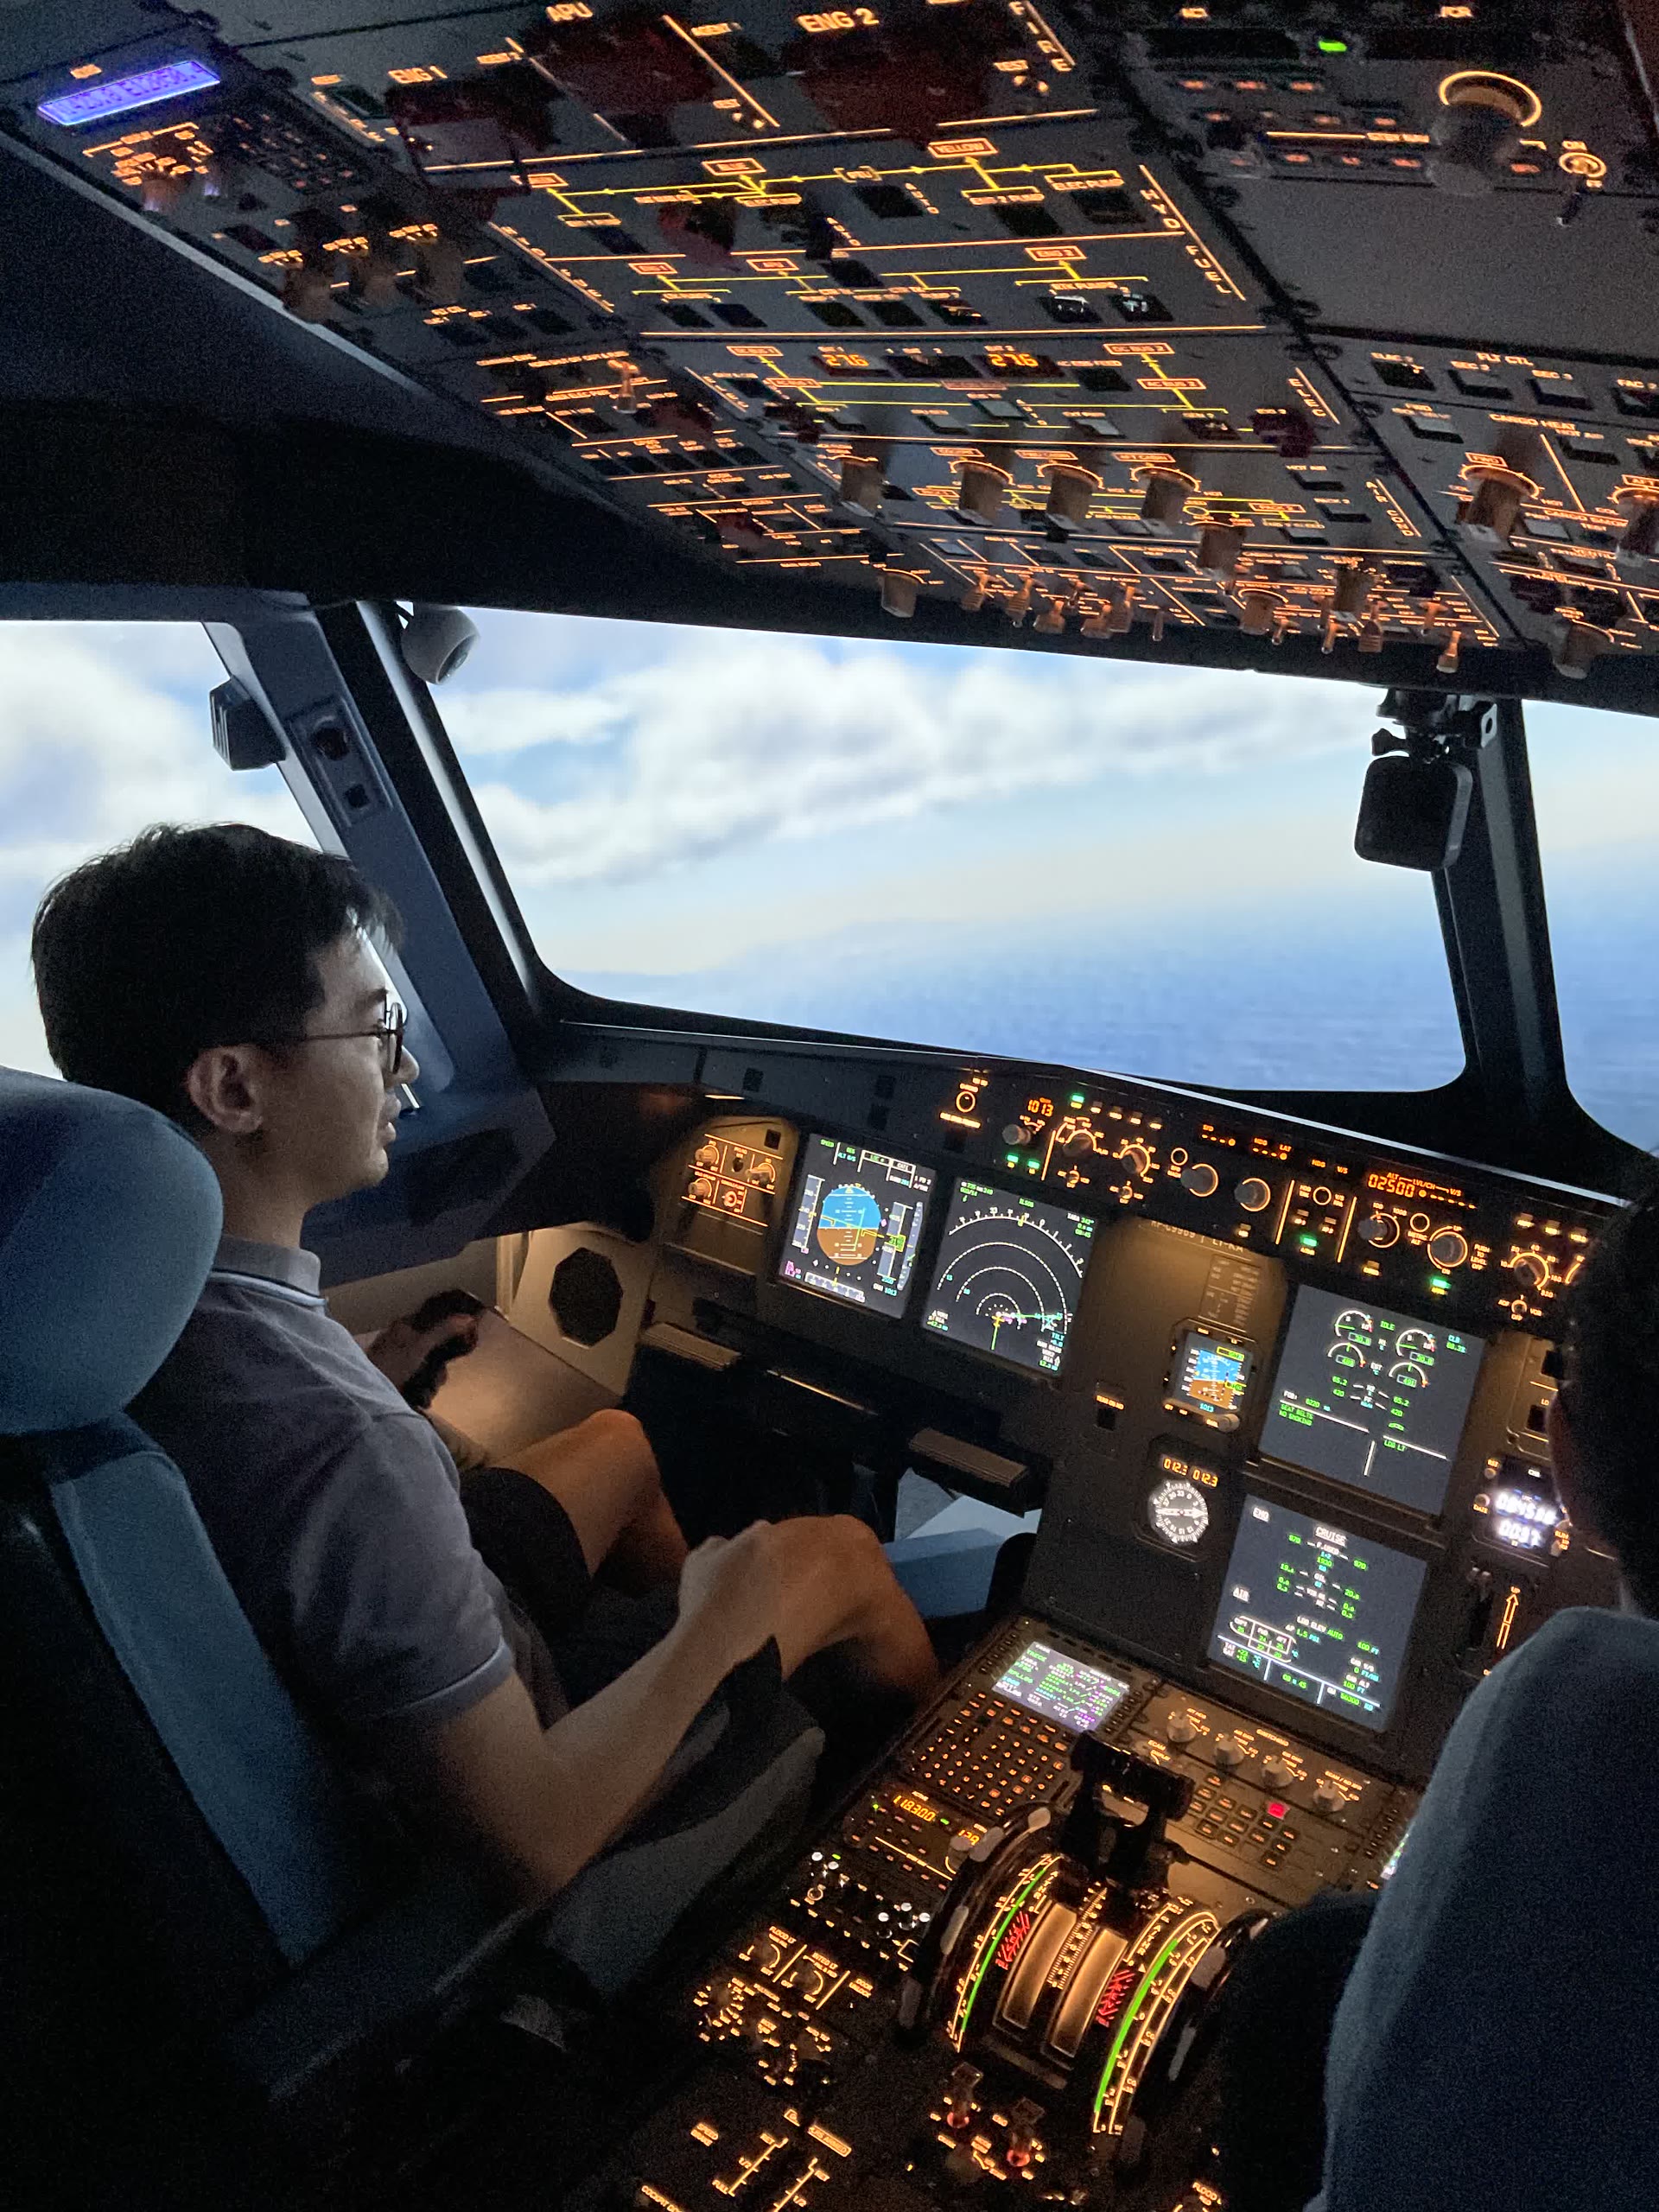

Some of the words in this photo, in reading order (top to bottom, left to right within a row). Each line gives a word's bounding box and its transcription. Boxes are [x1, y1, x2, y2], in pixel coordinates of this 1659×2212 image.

[546, 2, 593, 22] APU
[798, 11, 855, 32] ENG
[855, 8, 880, 25] 2
[388, 67, 433, 84] ENG
[430, 66, 448, 79] 1
[936, 143, 985, 154] YELLOW
[1140, 189, 1182, 229] HYD
[1477, 353, 1501, 363] FLT
[1504, 355, 1535, 366] CTL
[1617, 378, 1645, 388] FAC
[1489, 413, 1539, 426] CARGO
[1540, 420, 1576, 430] HEAT
[1027, 1099, 1054, 1117] 1013
[1279, 1143, 1293, 1153] LAT
[1312, 1159, 1326, 1168] HDG
[1367, 1173, 1415, 1198] 02500
[1386, 1172, 1400, 1181] ALT
[1412, 1179, 1436, 1191] LVL/CH
[1449, 1187, 1462, 1197] V/S
[1393, 1207, 1408, 1217] 1000
[1407, 1230, 1428, 1242] METRIC
[1410, 1237, 1422, 1246] ALT
[1474, 1243, 1491, 1253] PUSH
[1471, 1255, 1487, 1266] LEVEL
[1471, 1262, 1484, 1271] OFF
[1380, 1319, 1395, 1332] IDLE
[1447, 1334, 1461, 1344] CLB
[1332, 1375, 1348, 1387] 65.2
[1393, 1395, 1410, 1408] 65.2
[1280, 1403, 1294, 1414] SEAT
[1295, 1408, 1314, 1421] BELTS
[1390, 1408, 1404, 1418] 420
[1288, 1413, 1313, 1427] SMOKING
[1396, 1444, 1407, 1452] LT
[1192, 1469, 1218, 1488] 012.3
[1252, 1506, 1270, 1523] ENG
[1472, 1503, 1489, 1515] DATE
[1315, 1526, 1347, 1547] CRUISE
[1233, 1586, 1250, 1604] AIR
[1326, 1629, 1344, 1640] AUTO
[1357, 1641, 1370, 1651] 100
[1370, 1646, 1380, 1656] FT
[1298, 1680, 1307, 1689] 45
[1343, 1681, 1356, 1690] 100
[1357, 1686, 1365, 1694] FT
[1255, 1729, 1289, 1747] SWITCHING
[1147, 1739, 1166, 1751] ECAM
[769, 1925, 790, 1941] FLOOD
[696, 2121, 719, 2140] SPEED
[690, 2129, 714, 2147] BRAKE
[760, 2132, 776, 2145] RET
[738, 2157, 752, 2170] 1/2
[814, 2169, 830, 2182] RET
[712, 2178, 730, 2196] FULL
[1192, 2182, 1217, 2201] FLOOD
[641, 2184, 670, 2207] COCKPIT
[792, 2195, 808, 2208] 1/2
